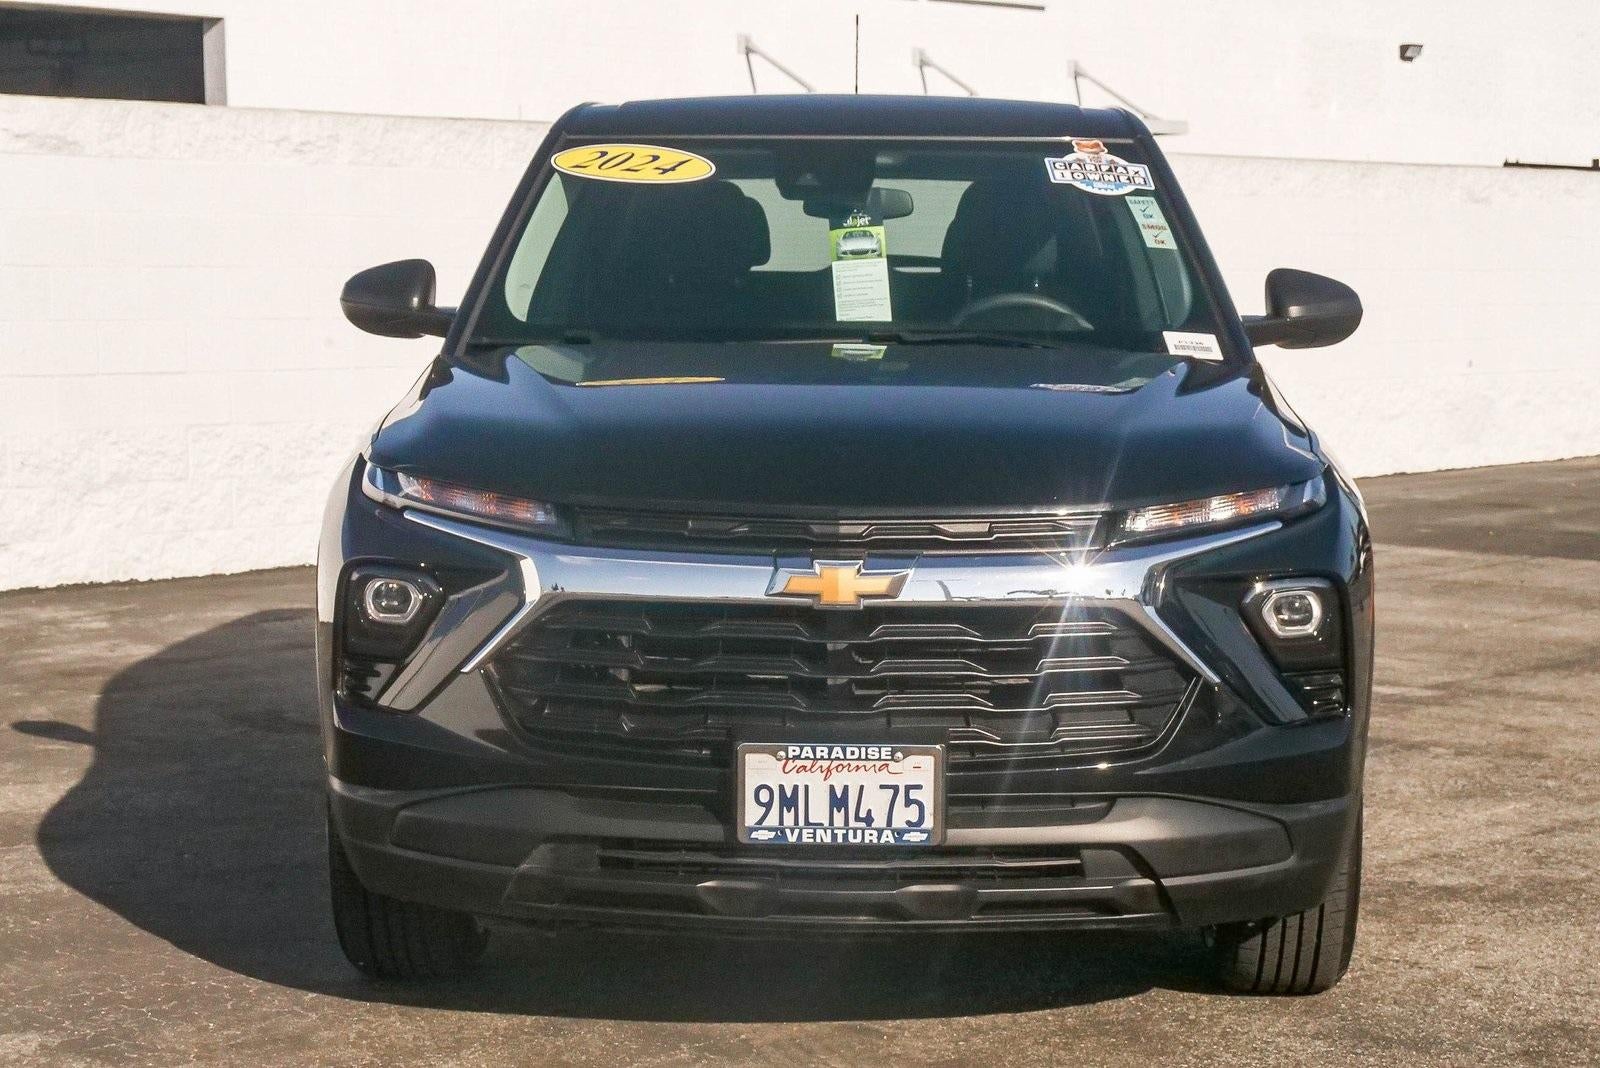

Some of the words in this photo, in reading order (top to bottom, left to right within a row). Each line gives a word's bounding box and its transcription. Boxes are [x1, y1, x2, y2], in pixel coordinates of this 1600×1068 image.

[567, 150, 693, 175] 2024
[1053, 161, 1144, 176] CARFAX
[1071, 171, 1148, 185] OWNER
[787, 746, 892, 760] PARADISE
[780, 759, 904, 782] California
[753, 783, 926, 828] 9MLM475
[785, 828, 897, 844] VENTURA
